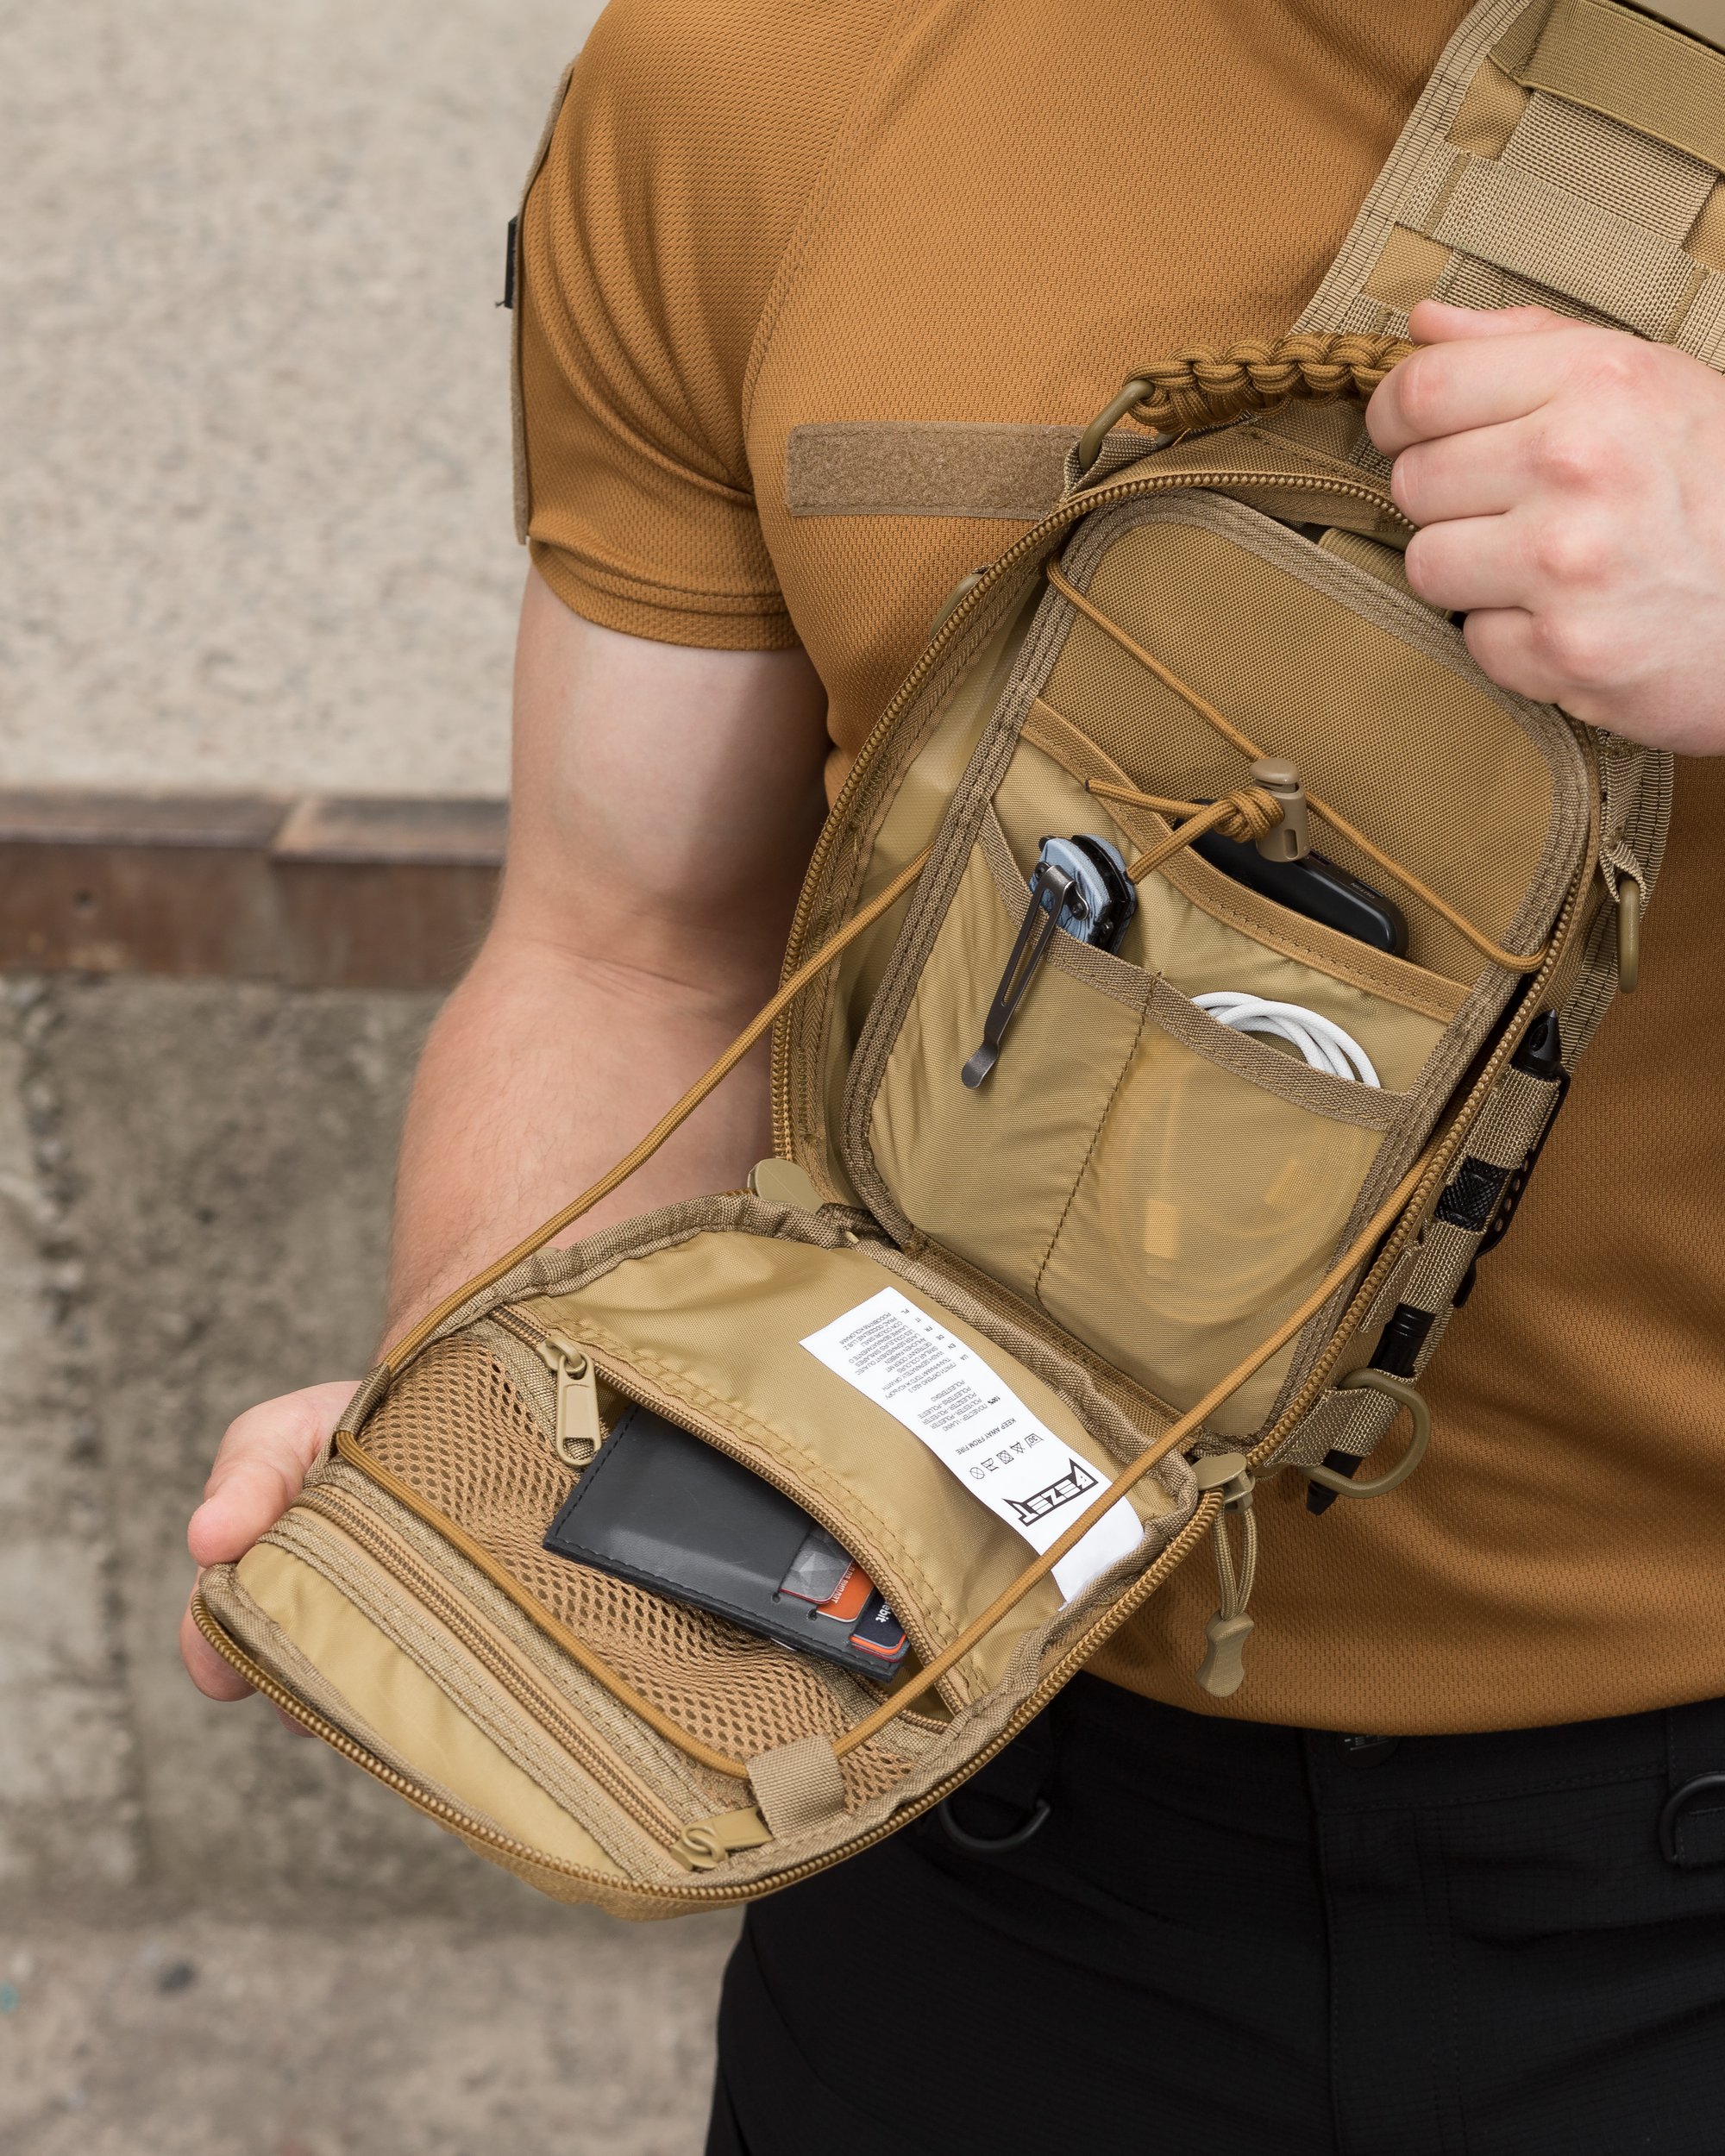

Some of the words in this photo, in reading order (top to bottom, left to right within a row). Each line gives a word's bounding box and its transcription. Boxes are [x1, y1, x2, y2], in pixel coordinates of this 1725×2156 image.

[862, 1312, 891, 1330] PODOBNYMI
[889, 1320, 903, 1330] CON
[837, 1326, 864, 1344] KOLORAMI
[874, 1327, 892, 1338] COLORI
[889, 1324, 908, 1338] LAVARE
[902, 1328, 914, 1337] LES
[846, 1338, 858, 1348] LUB
[879, 1333, 906, 1351] COULEURS
[904, 1332, 920, 1344] LAVER
[852, 1334, 892, 1361] SEPARATAMENTE
[906, 1341, 932, 1358] GETRENNT
[918, 1345, 938, 1359] SIMILAR
[854, 1349, 881, 1367] SIMILAIRES
[883, 1351, 905, 1364] FARBEN
[892, 1356, 908, 1367] ODER
[928, 1350, 944, 1362] WASH
[854, 1364, 869, 1376] AVEC
[895, 1357, 920, 1373] COLOURS
[881, 1381, 895, 1391] WITH
[954, 1397, 982, 1415] POLYESTER
[987, 1395, 1000, 1405] 100%
[921, 1408, 948, 1425] POLYESTER
[929, 1413, 955, 1429] POLIESTER
[999, 1417, 1016, 1429] KEEP
[982, 1426, 1001, 1439] AWAY
[967, 1435, 986, 1448] FROM
[954, 1445, 969, 1455] FIRE
[1003, 1458, 1098, 1526] BEZET
